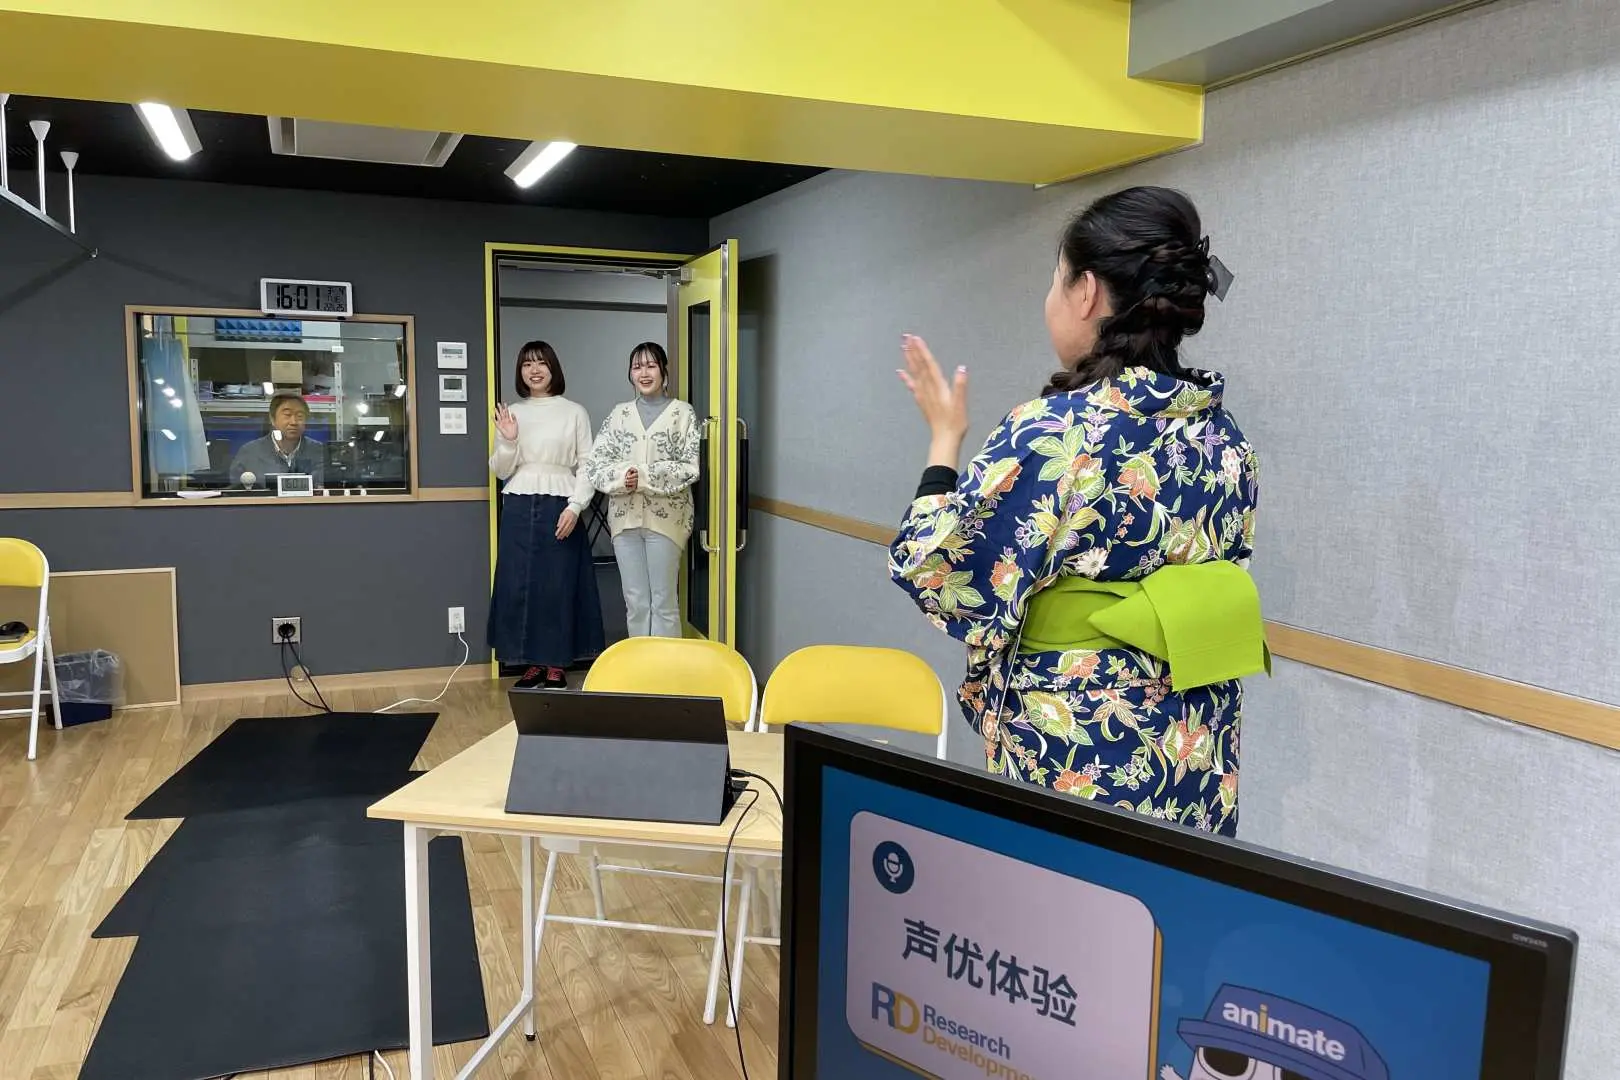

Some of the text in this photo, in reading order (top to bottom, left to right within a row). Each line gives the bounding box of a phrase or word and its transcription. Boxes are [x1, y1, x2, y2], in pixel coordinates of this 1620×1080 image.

[902, 917, 1078, 1027] 声优体验
[871, 981, 920, 1035] RD
[923, 1004, 1011, 1060] Research
[1222, 1002, 1346, 1061] animate
[922, 1026, 1036, 1080] Developm
